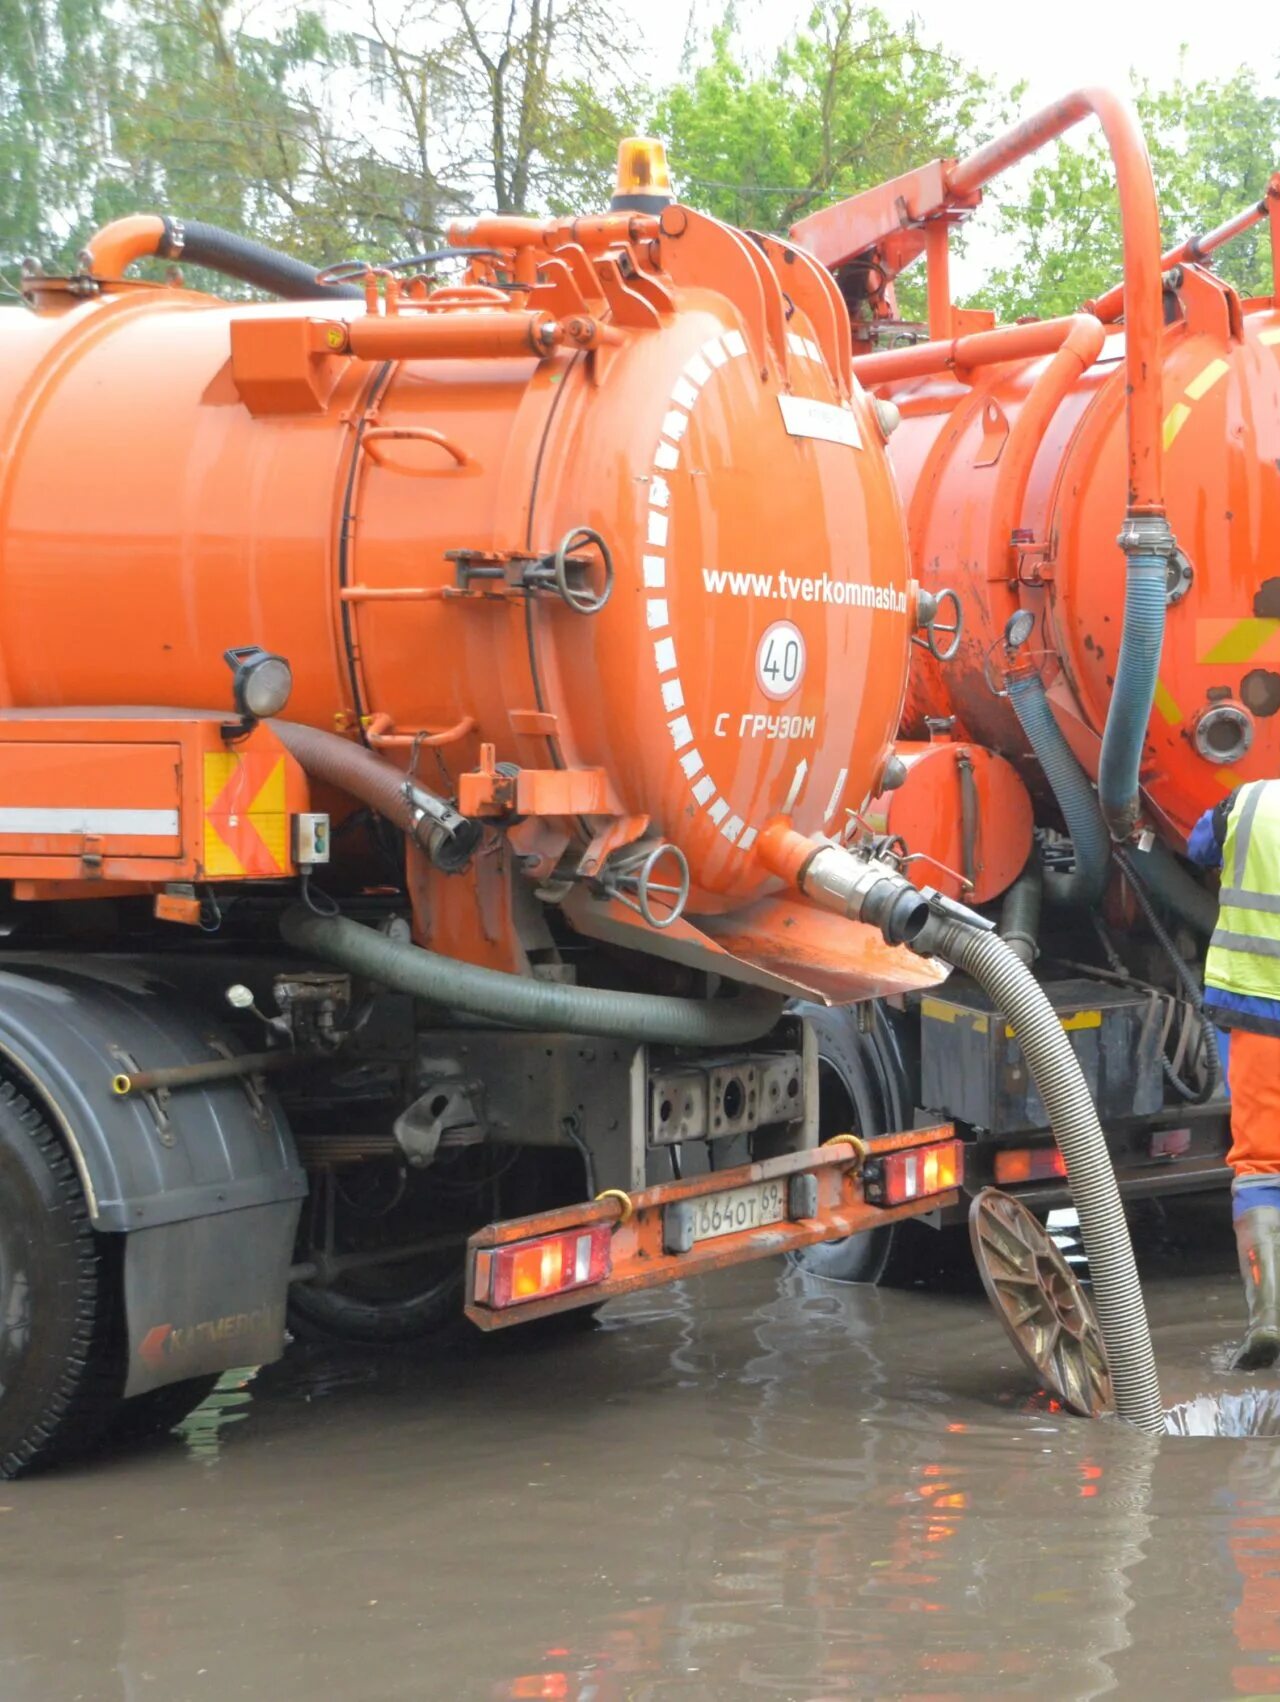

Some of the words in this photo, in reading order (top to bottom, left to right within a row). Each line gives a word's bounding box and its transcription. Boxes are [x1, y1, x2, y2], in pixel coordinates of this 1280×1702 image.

[703, 568, 907, 614] www.tverkommash.ru
[763, 639, 798, 682] 40
[715, 712, 730, 737] С
[738, 714, 816, 739] ГРУЗОМ
